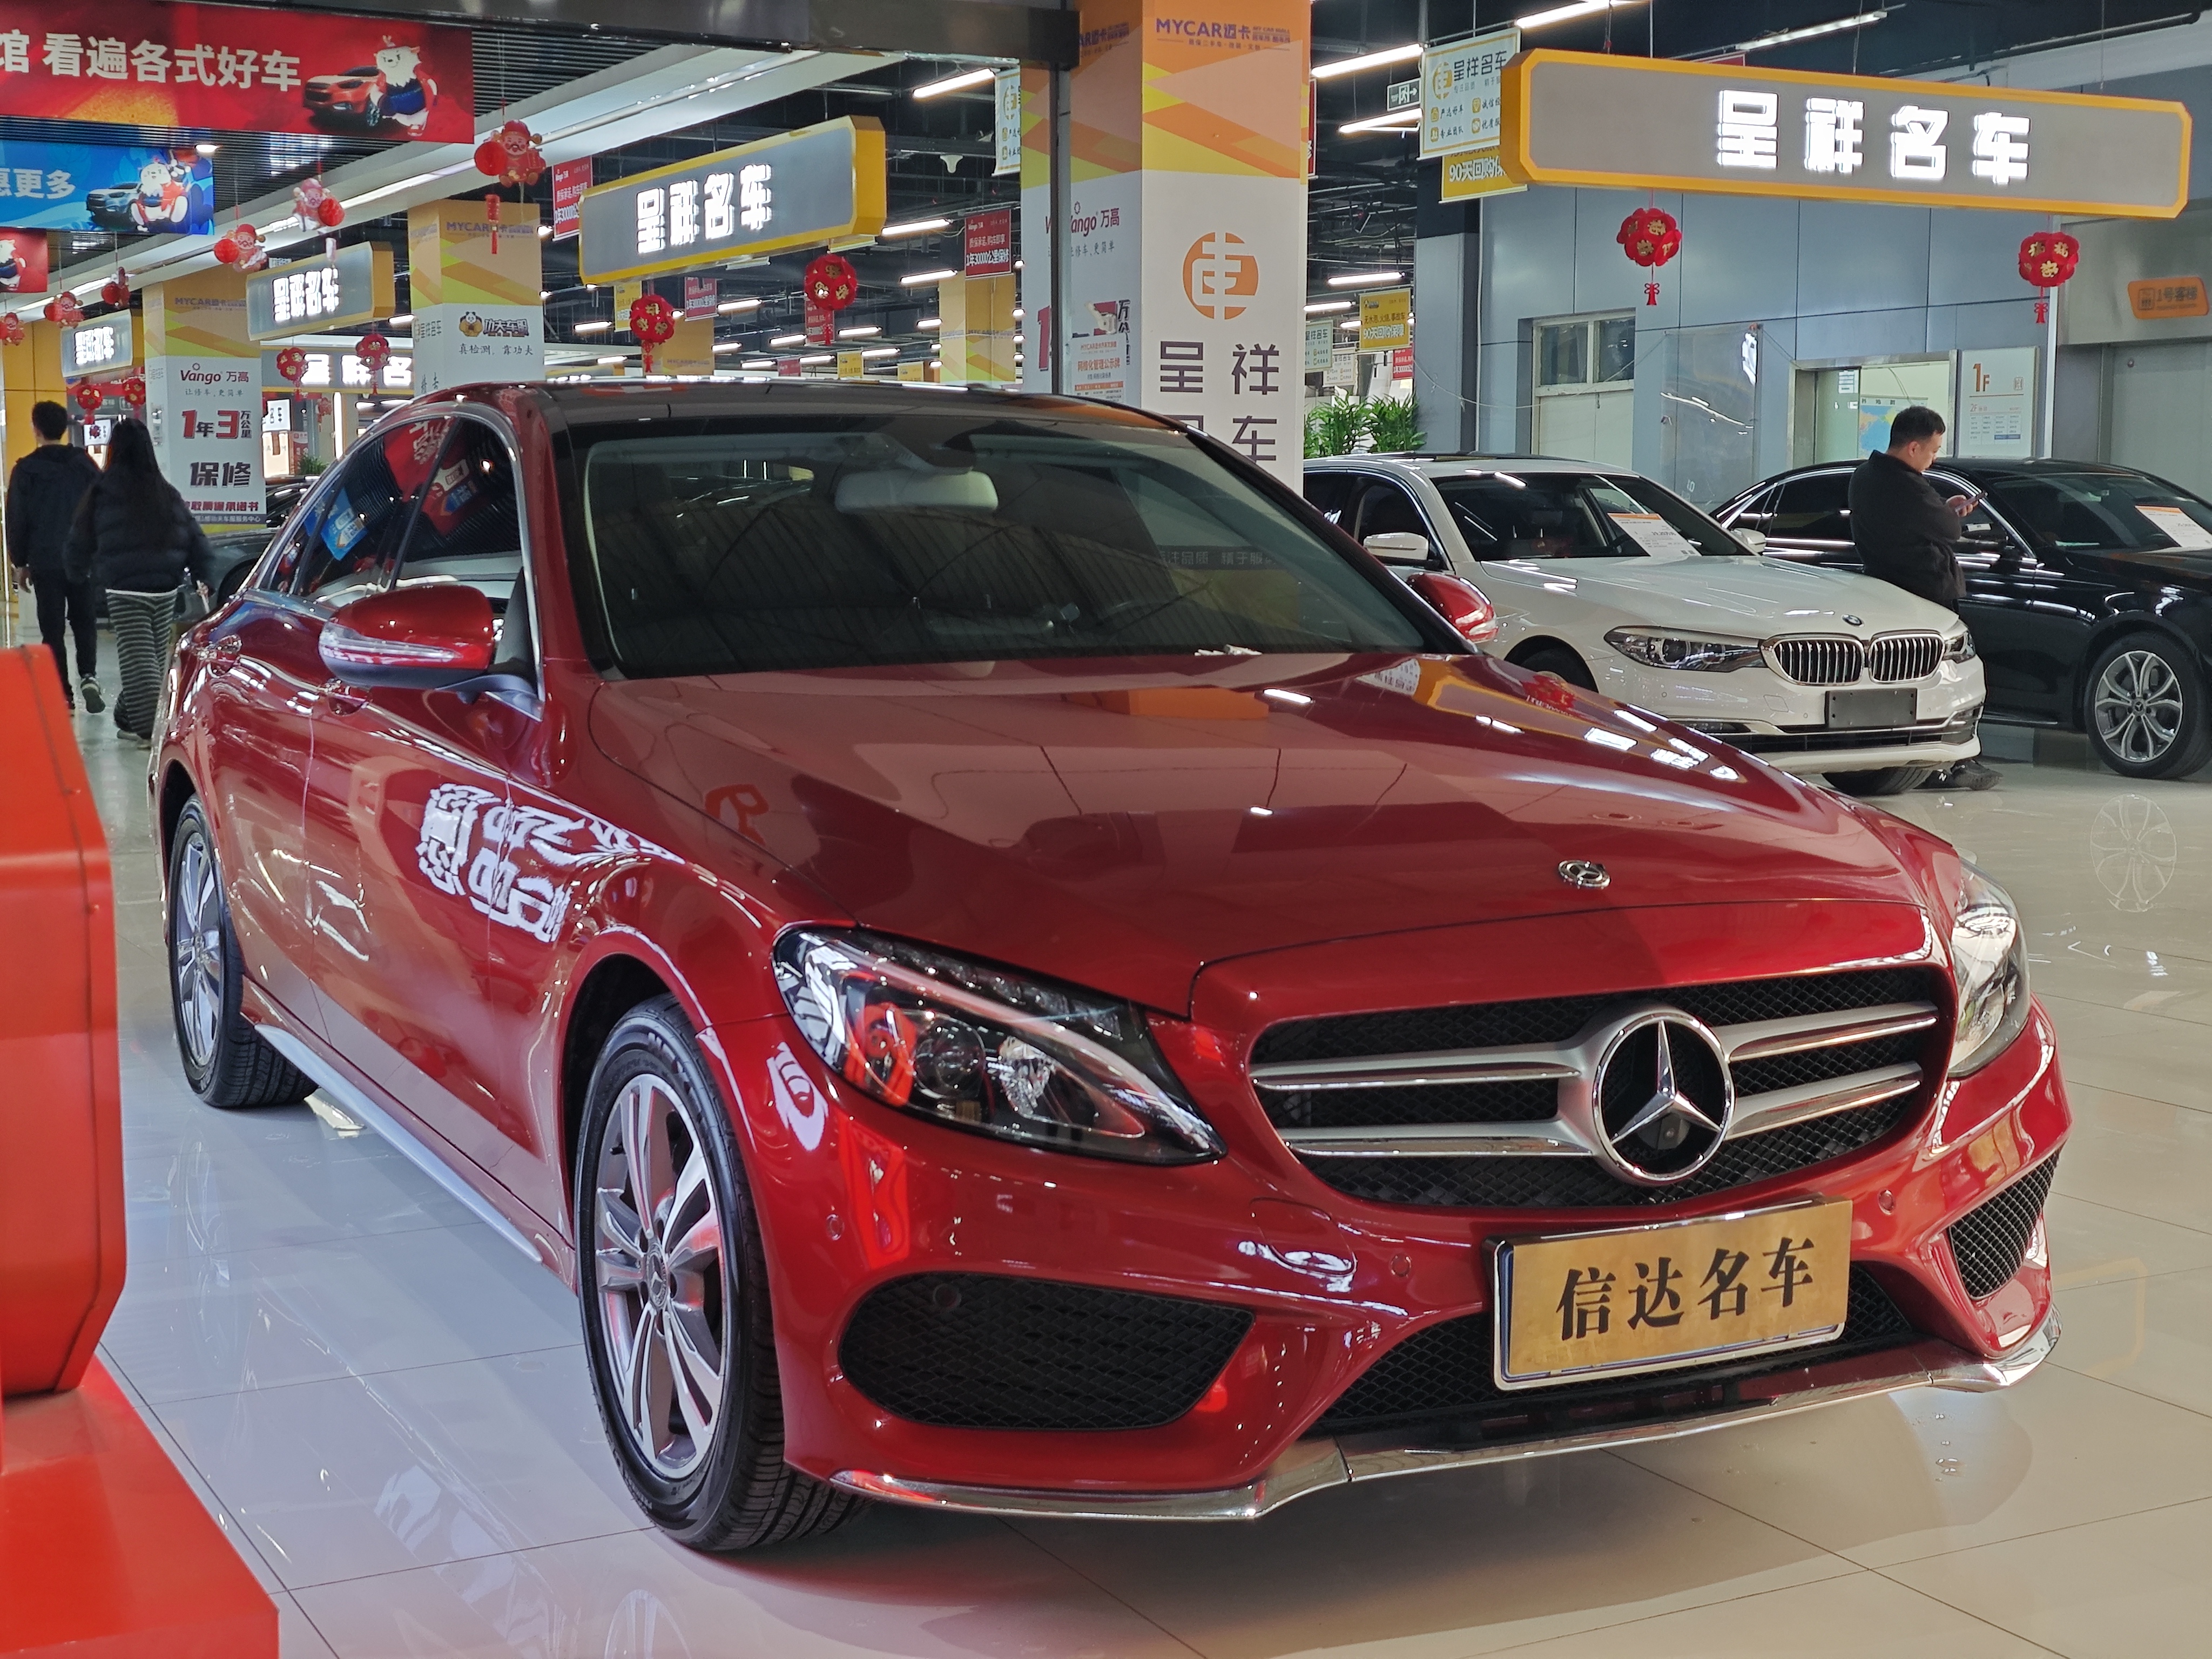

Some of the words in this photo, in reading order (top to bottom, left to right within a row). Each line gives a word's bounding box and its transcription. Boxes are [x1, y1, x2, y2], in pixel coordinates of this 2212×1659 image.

[42, 32, 301, 92] 看遍各式好车
[1454, 50, 1508, 82] 呈祥名车
[1440, 125, 1464, 139] 专业团队
[1717, 89, 2031, 184] 呈祥名车
[637, 164, 772, 254] 呈祥名车
[1100, 207, 1120, 228] 万高
[446, 221, 508, 233] MYCAR卡
[272, 267, 340, 318] 呈祥名车
[483, 318, 529, 336] 功夫车盟
[1363, 323, 1405, 340] 90天回购保障
[180, 370, 221, 385] Vango
[226, 371, 249, 383] 万高
[1973, 363, 1990, 392] 1F
[190, 462, 251, 487] 保修
[1555, 1237, 1815, 1341] 信达名车
